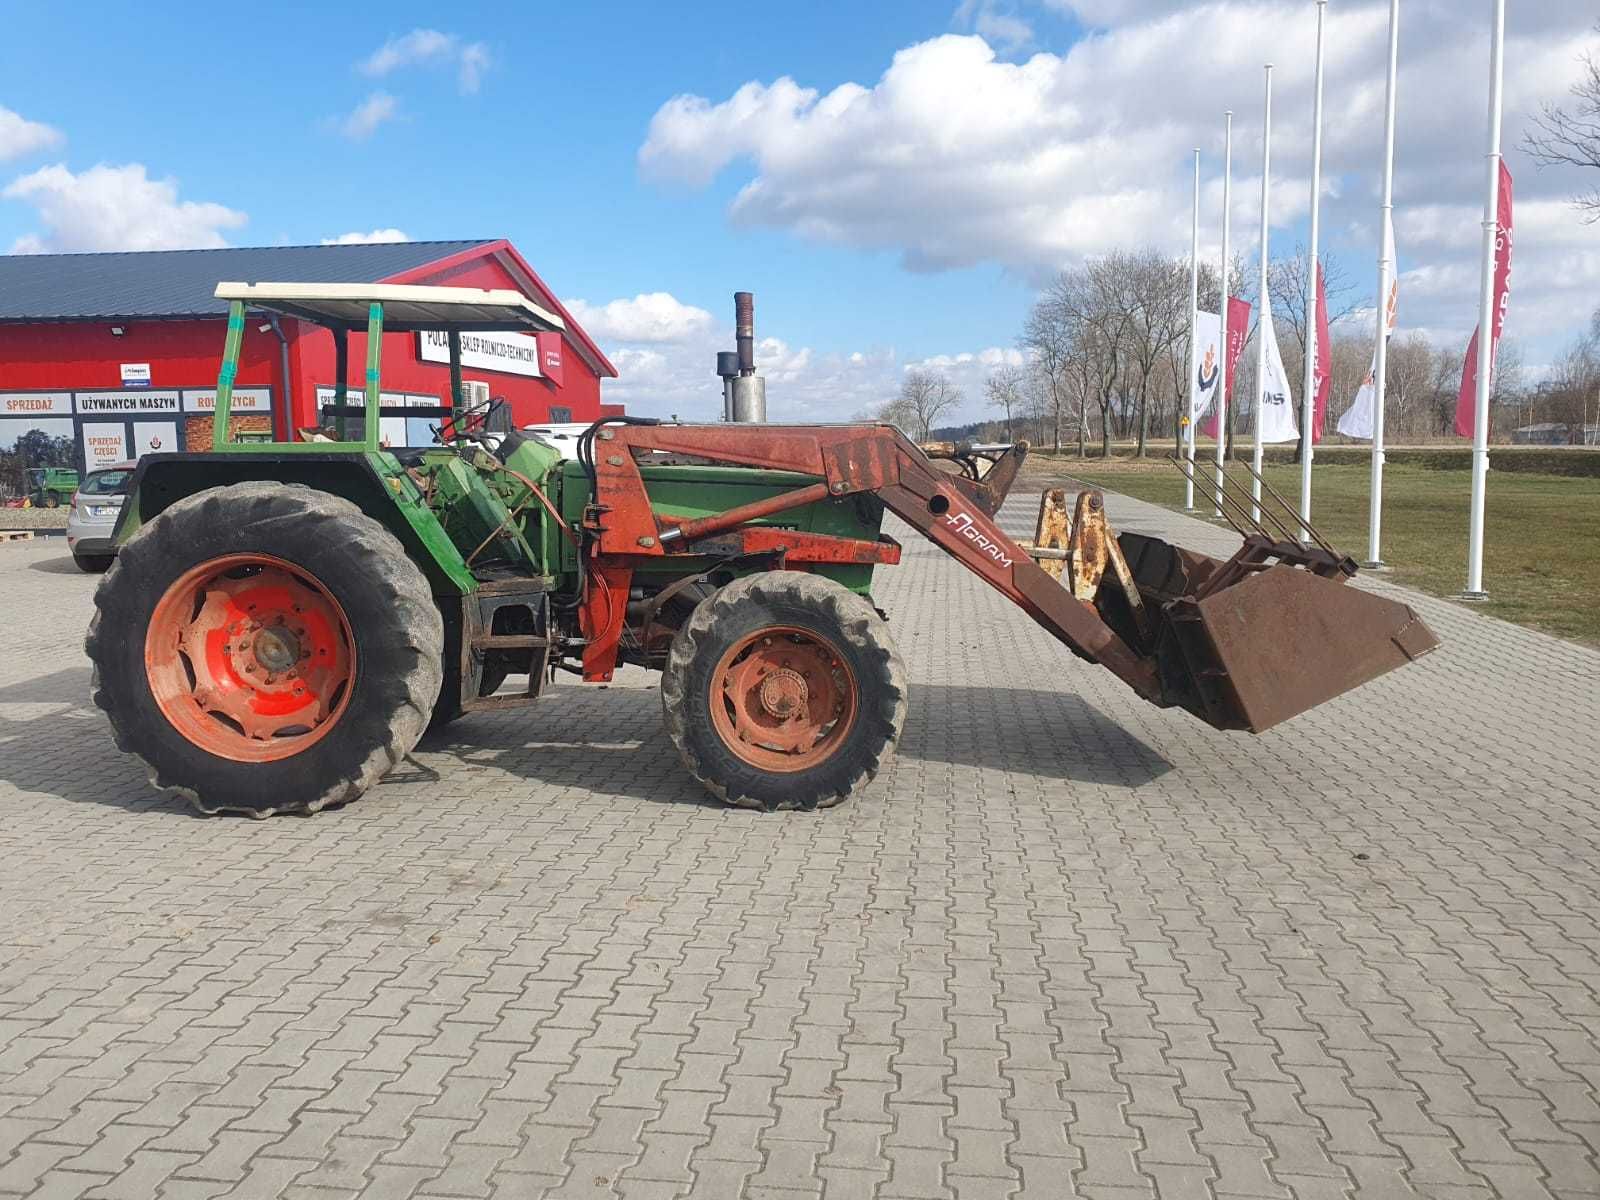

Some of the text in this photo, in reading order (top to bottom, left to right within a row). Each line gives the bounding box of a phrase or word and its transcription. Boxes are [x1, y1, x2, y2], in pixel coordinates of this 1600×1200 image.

[462, 335, 480, 353] SKLEP
[481, 338, 535, 362] ROLNICZO-TECHNICZNY
[6, 397, 54, 410] SPRZEDAŻ
[82, 396, 176, 410] UŻYWANYCH MASZYN
[945, 512, 1013, 568] AGRAM
